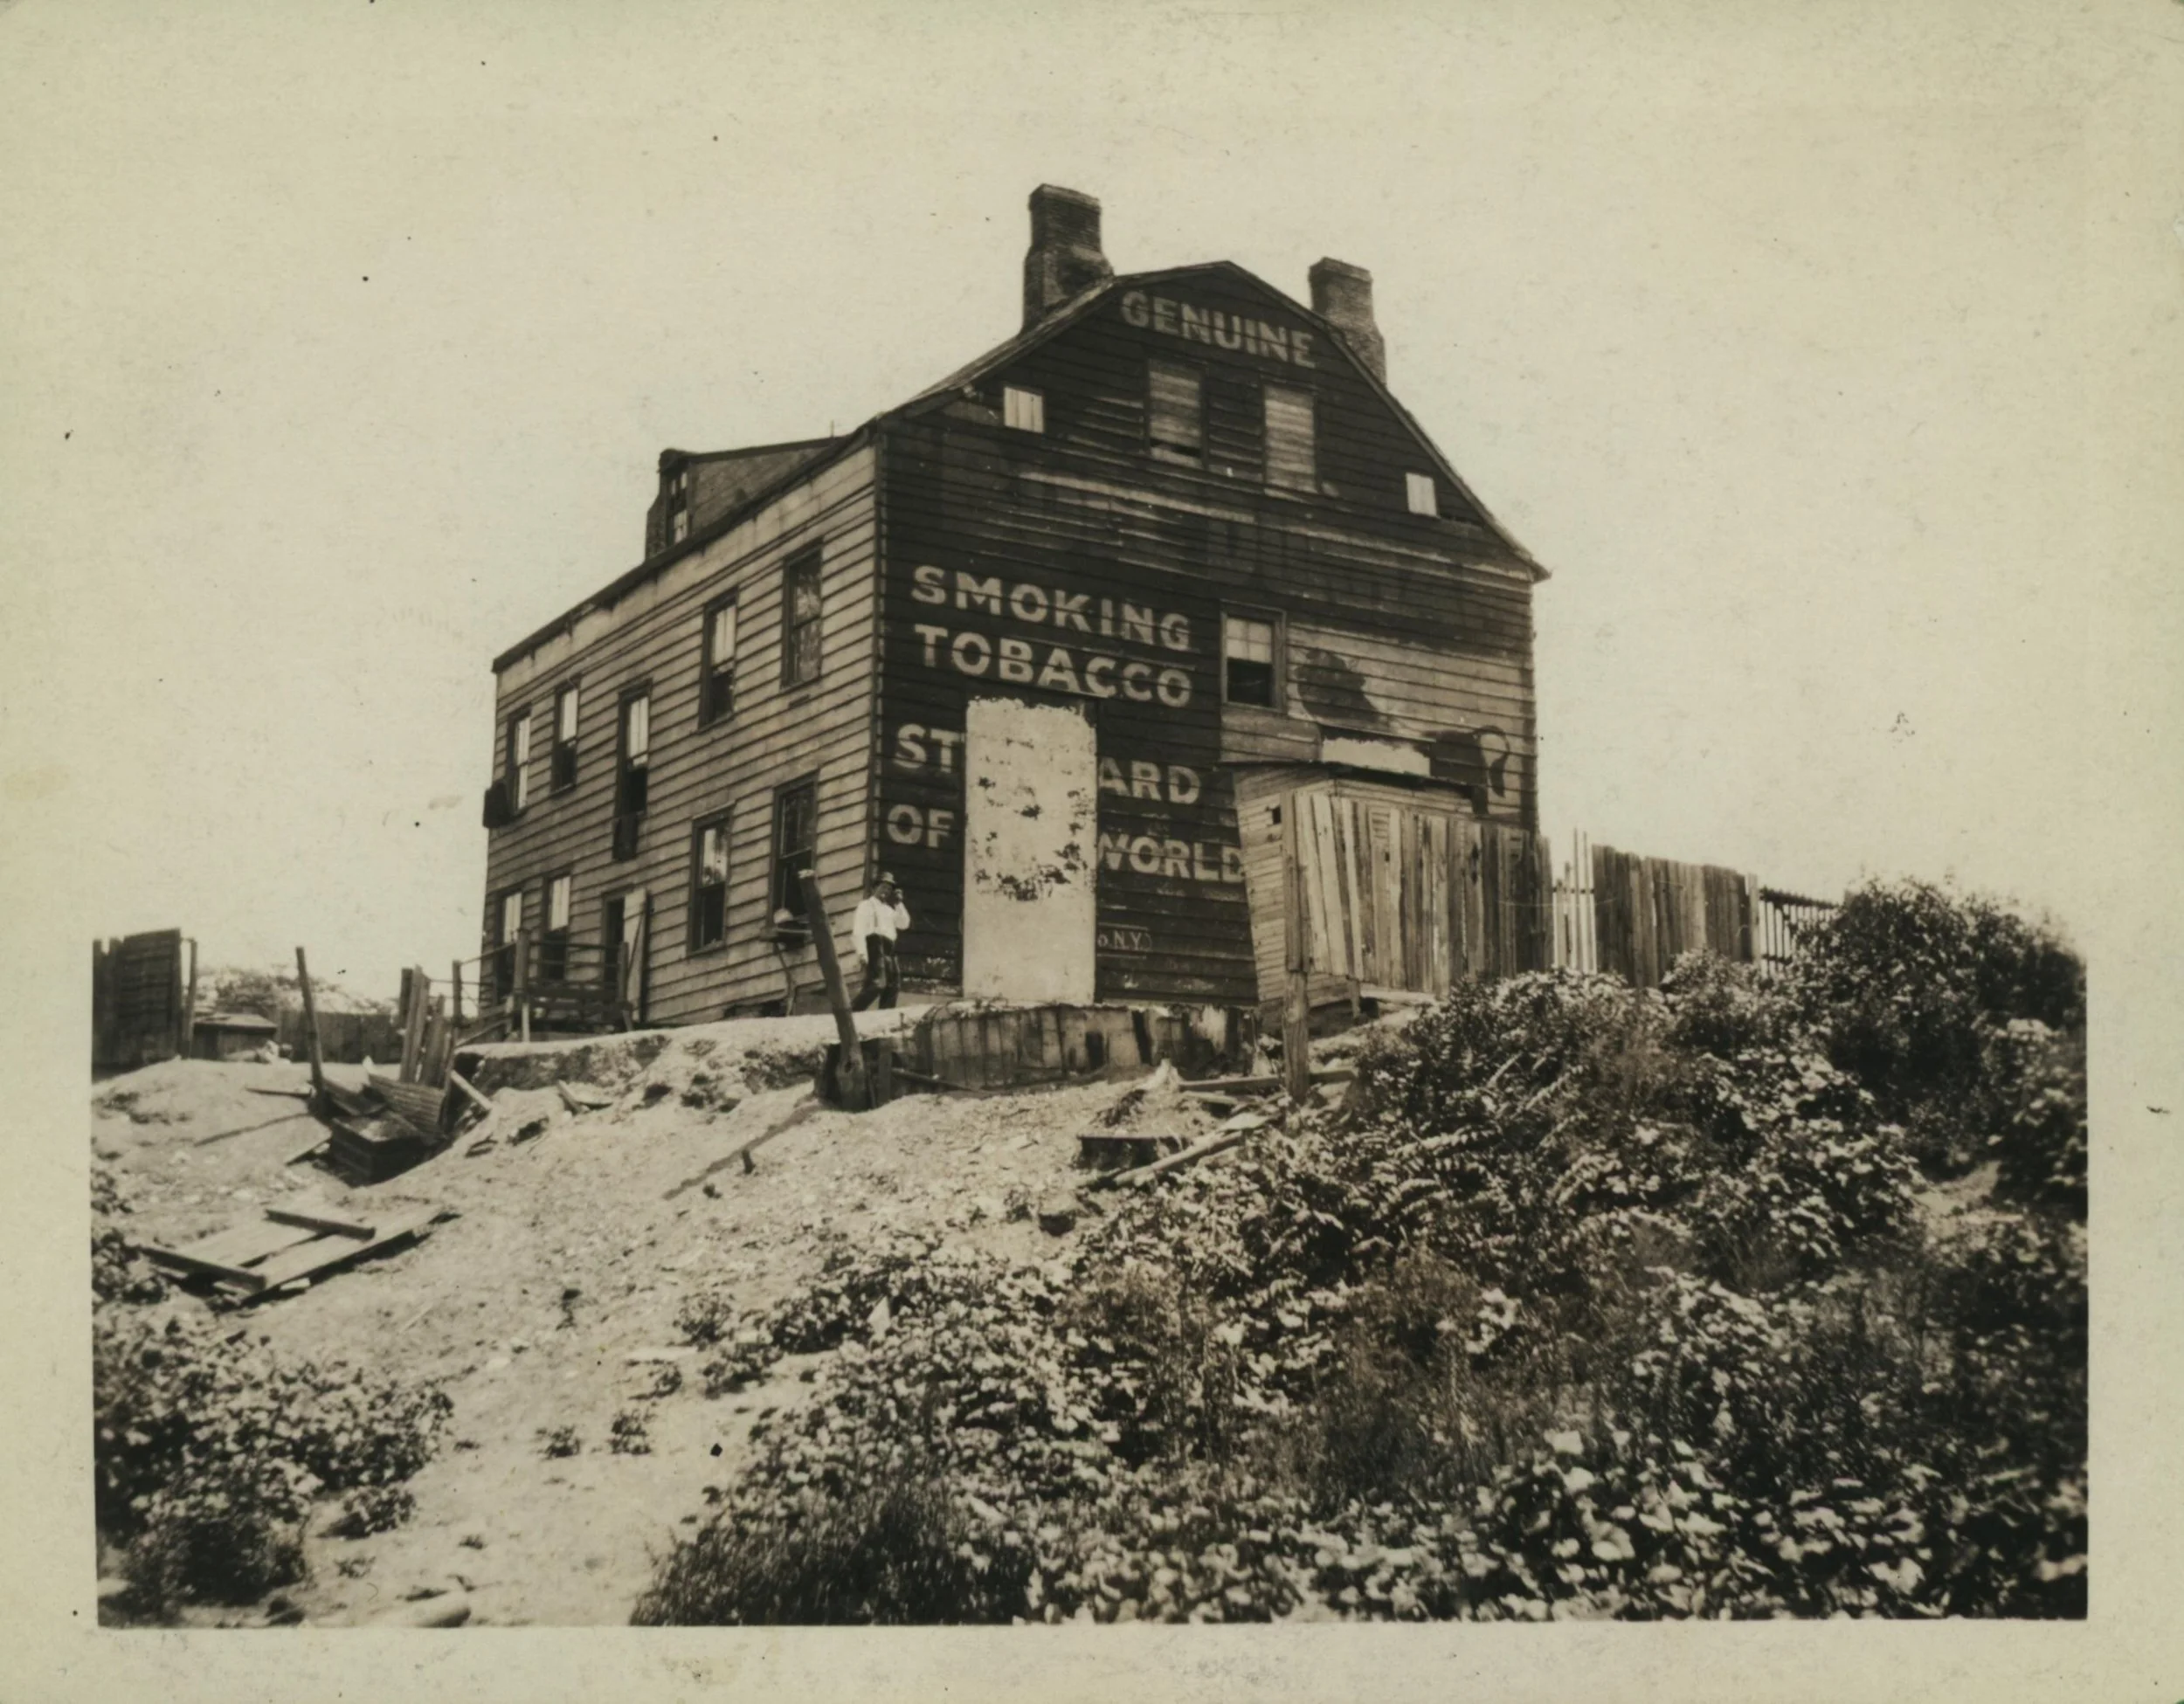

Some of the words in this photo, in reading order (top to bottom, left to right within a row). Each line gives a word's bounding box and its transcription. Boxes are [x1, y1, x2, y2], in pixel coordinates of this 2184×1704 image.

[1123, 291, 1316, 369] GENUINE
[911, 565, 1192, 652] SMOKING
[915, 624, 1193, 707] TOBACCO
[887, 804, 954, 848] OF
